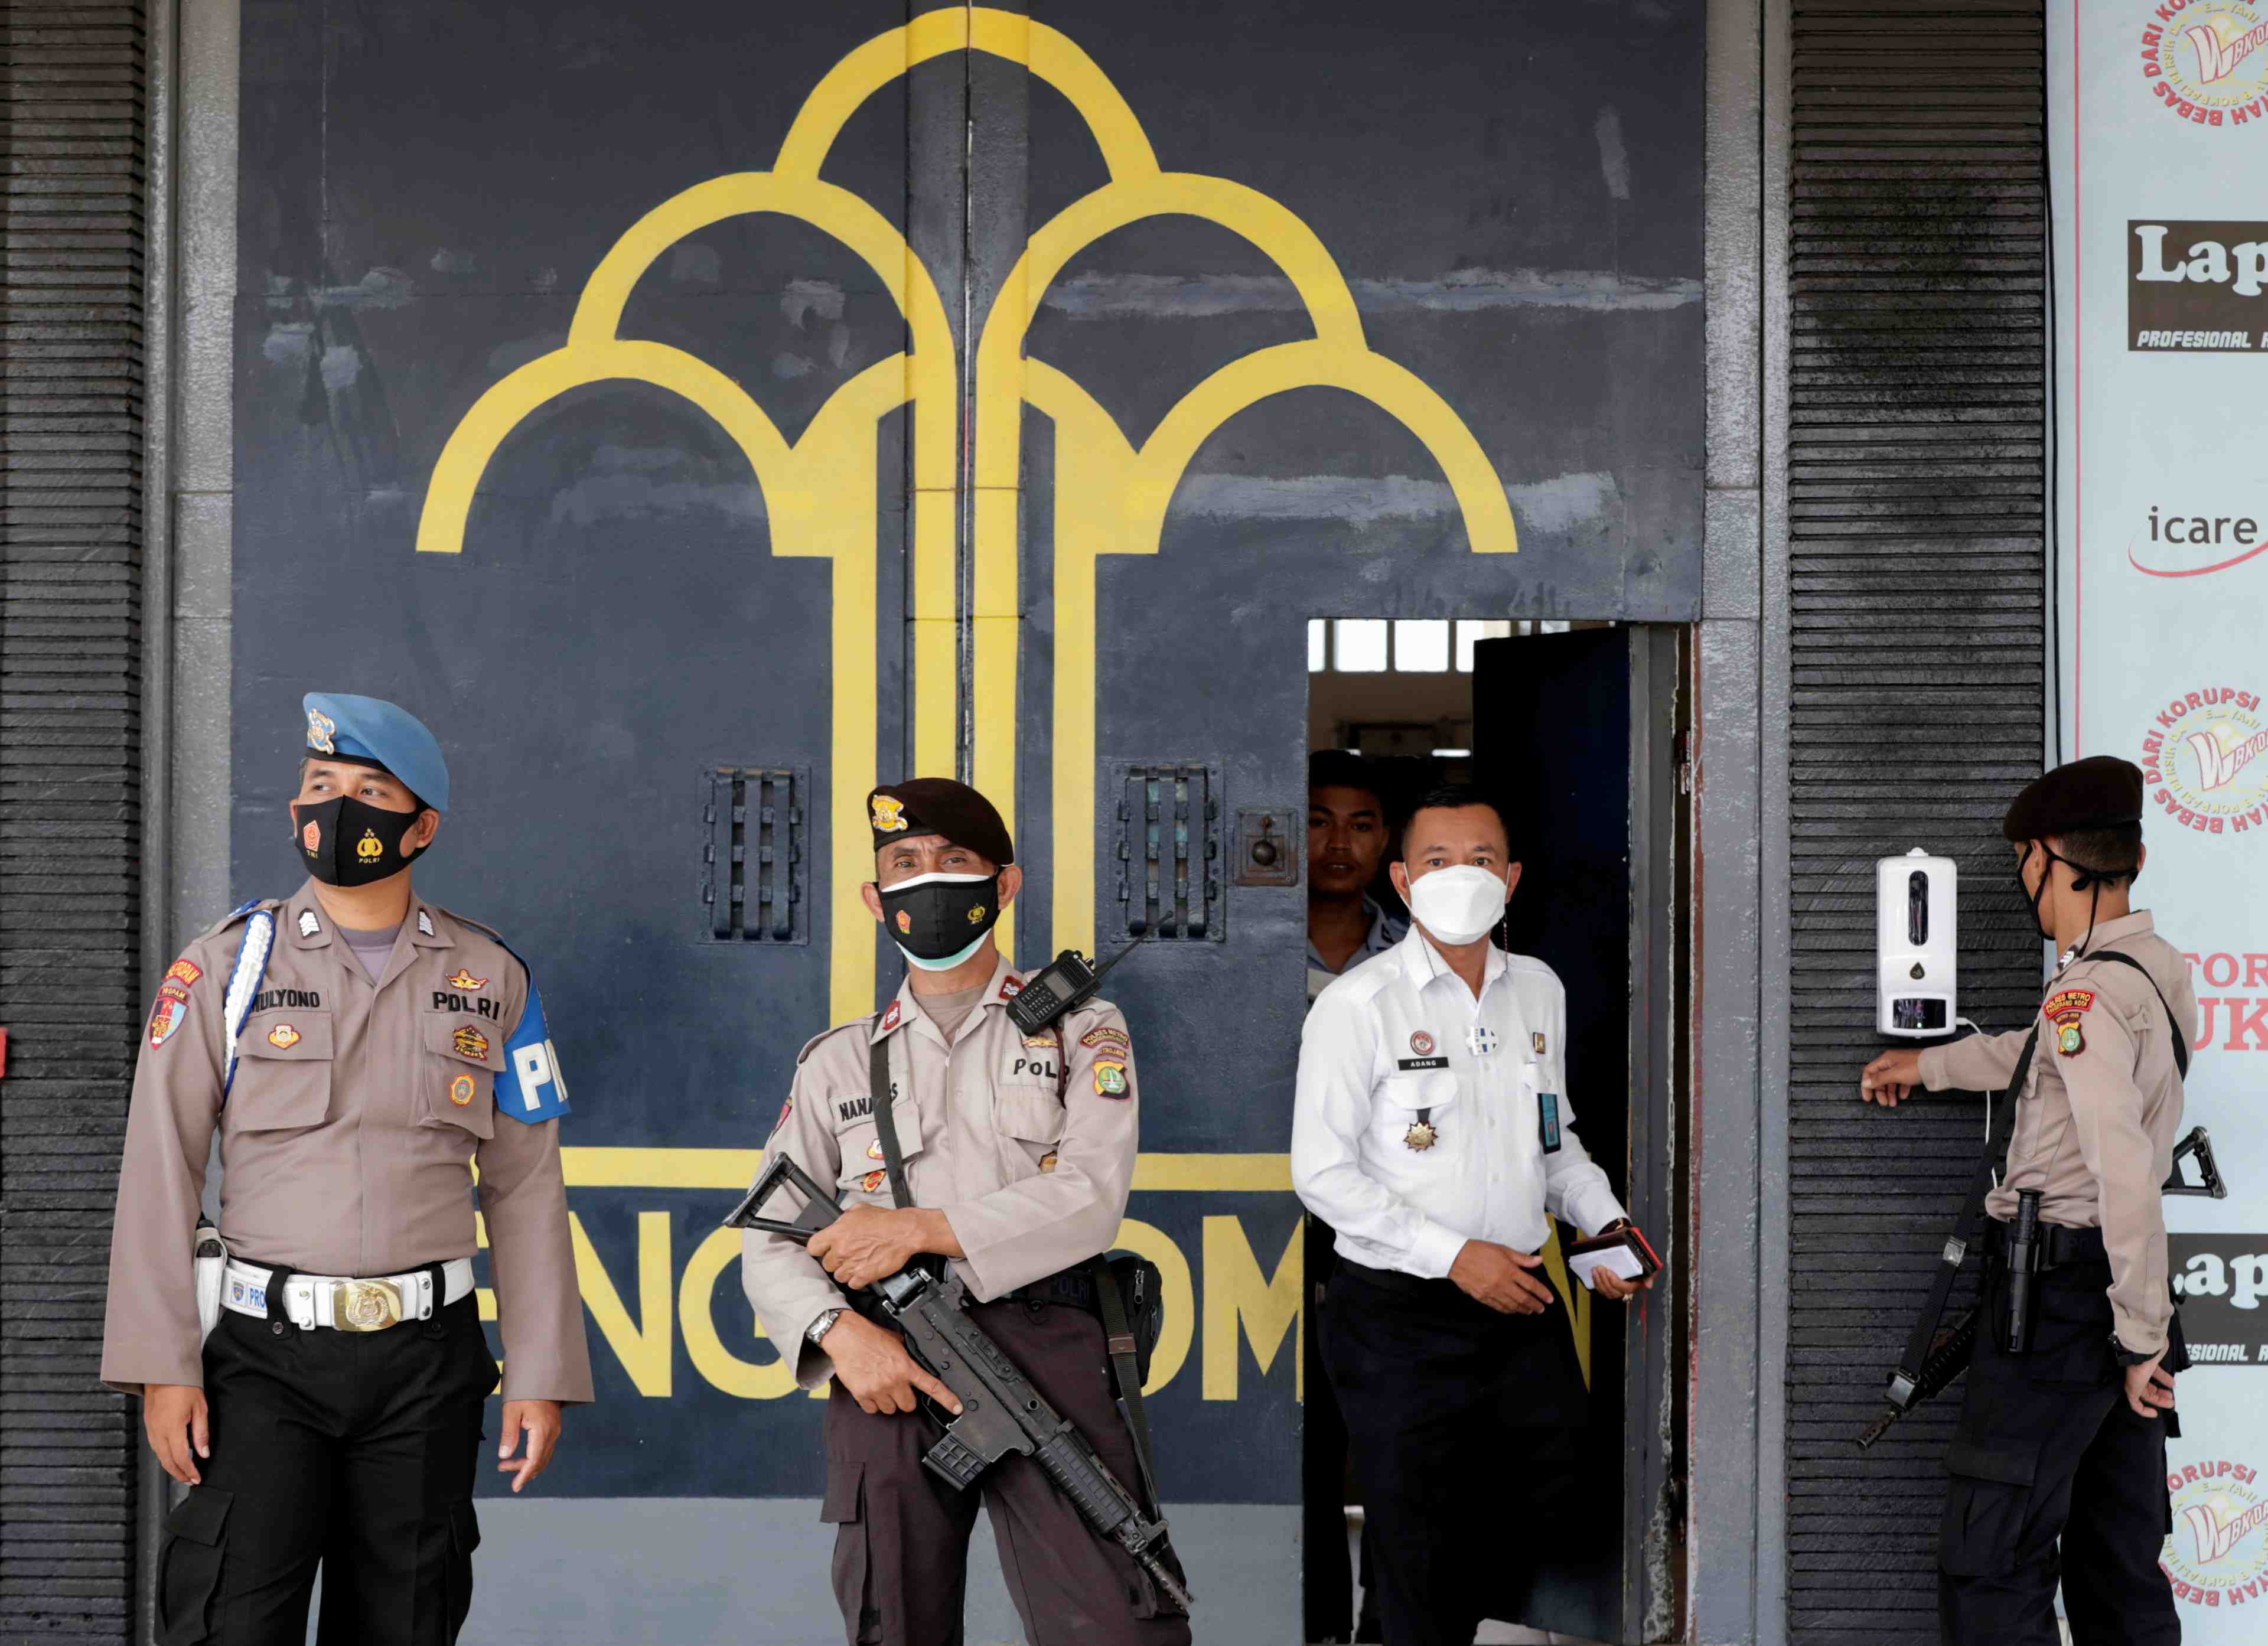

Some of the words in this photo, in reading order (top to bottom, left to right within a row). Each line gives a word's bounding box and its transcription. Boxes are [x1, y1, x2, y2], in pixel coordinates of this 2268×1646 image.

[2141, 22, 2164, 77] DARI
[2153, 81, 2223, 126] BEBAS
[2135, 224, 2268, 296] Lap
[2137, 331, 2251, 348] PROFESIONAL
[2148, 506, 2257, 545] icare
[2156, 687, 2260, 728] KORUPSI
[2142, 729, 2164, 784] DARI
[2154, 788, 2223, 833] BEBAS
[432, 992, 500, 1021] POLRI
[1410, 1060, 1436, 1068] ADANG
[2173, 1253, 2268, 1309] ap
[2167, 1461, 2257, 1490] ORUPSI
